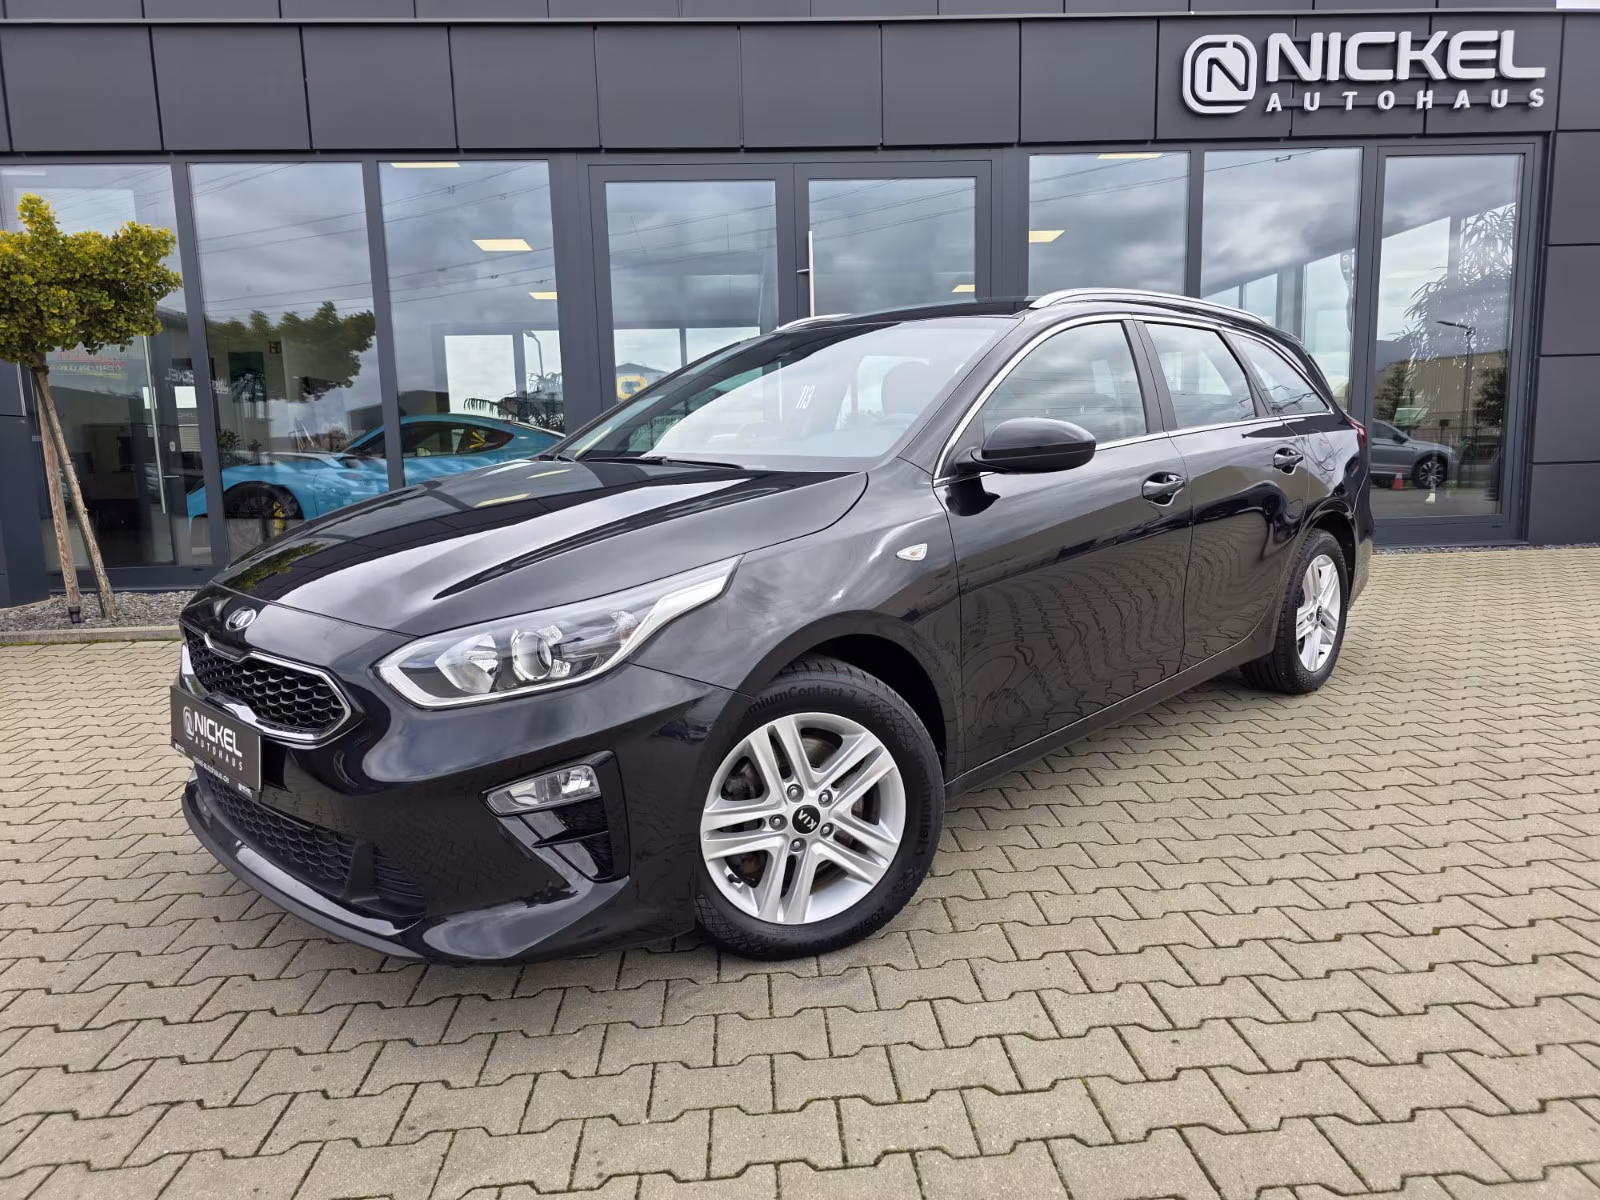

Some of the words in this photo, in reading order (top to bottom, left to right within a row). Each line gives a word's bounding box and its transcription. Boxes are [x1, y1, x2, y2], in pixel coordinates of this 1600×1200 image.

[1265, 30, 1546, 82] NICKEL
[1265, 88, 1545, 113] AUTOHAUS
[194, 710, 243, 758] NICKEL
[194, 736, 243, 772] AUTOHAUS
[797, 809, 818, 830] KIA
